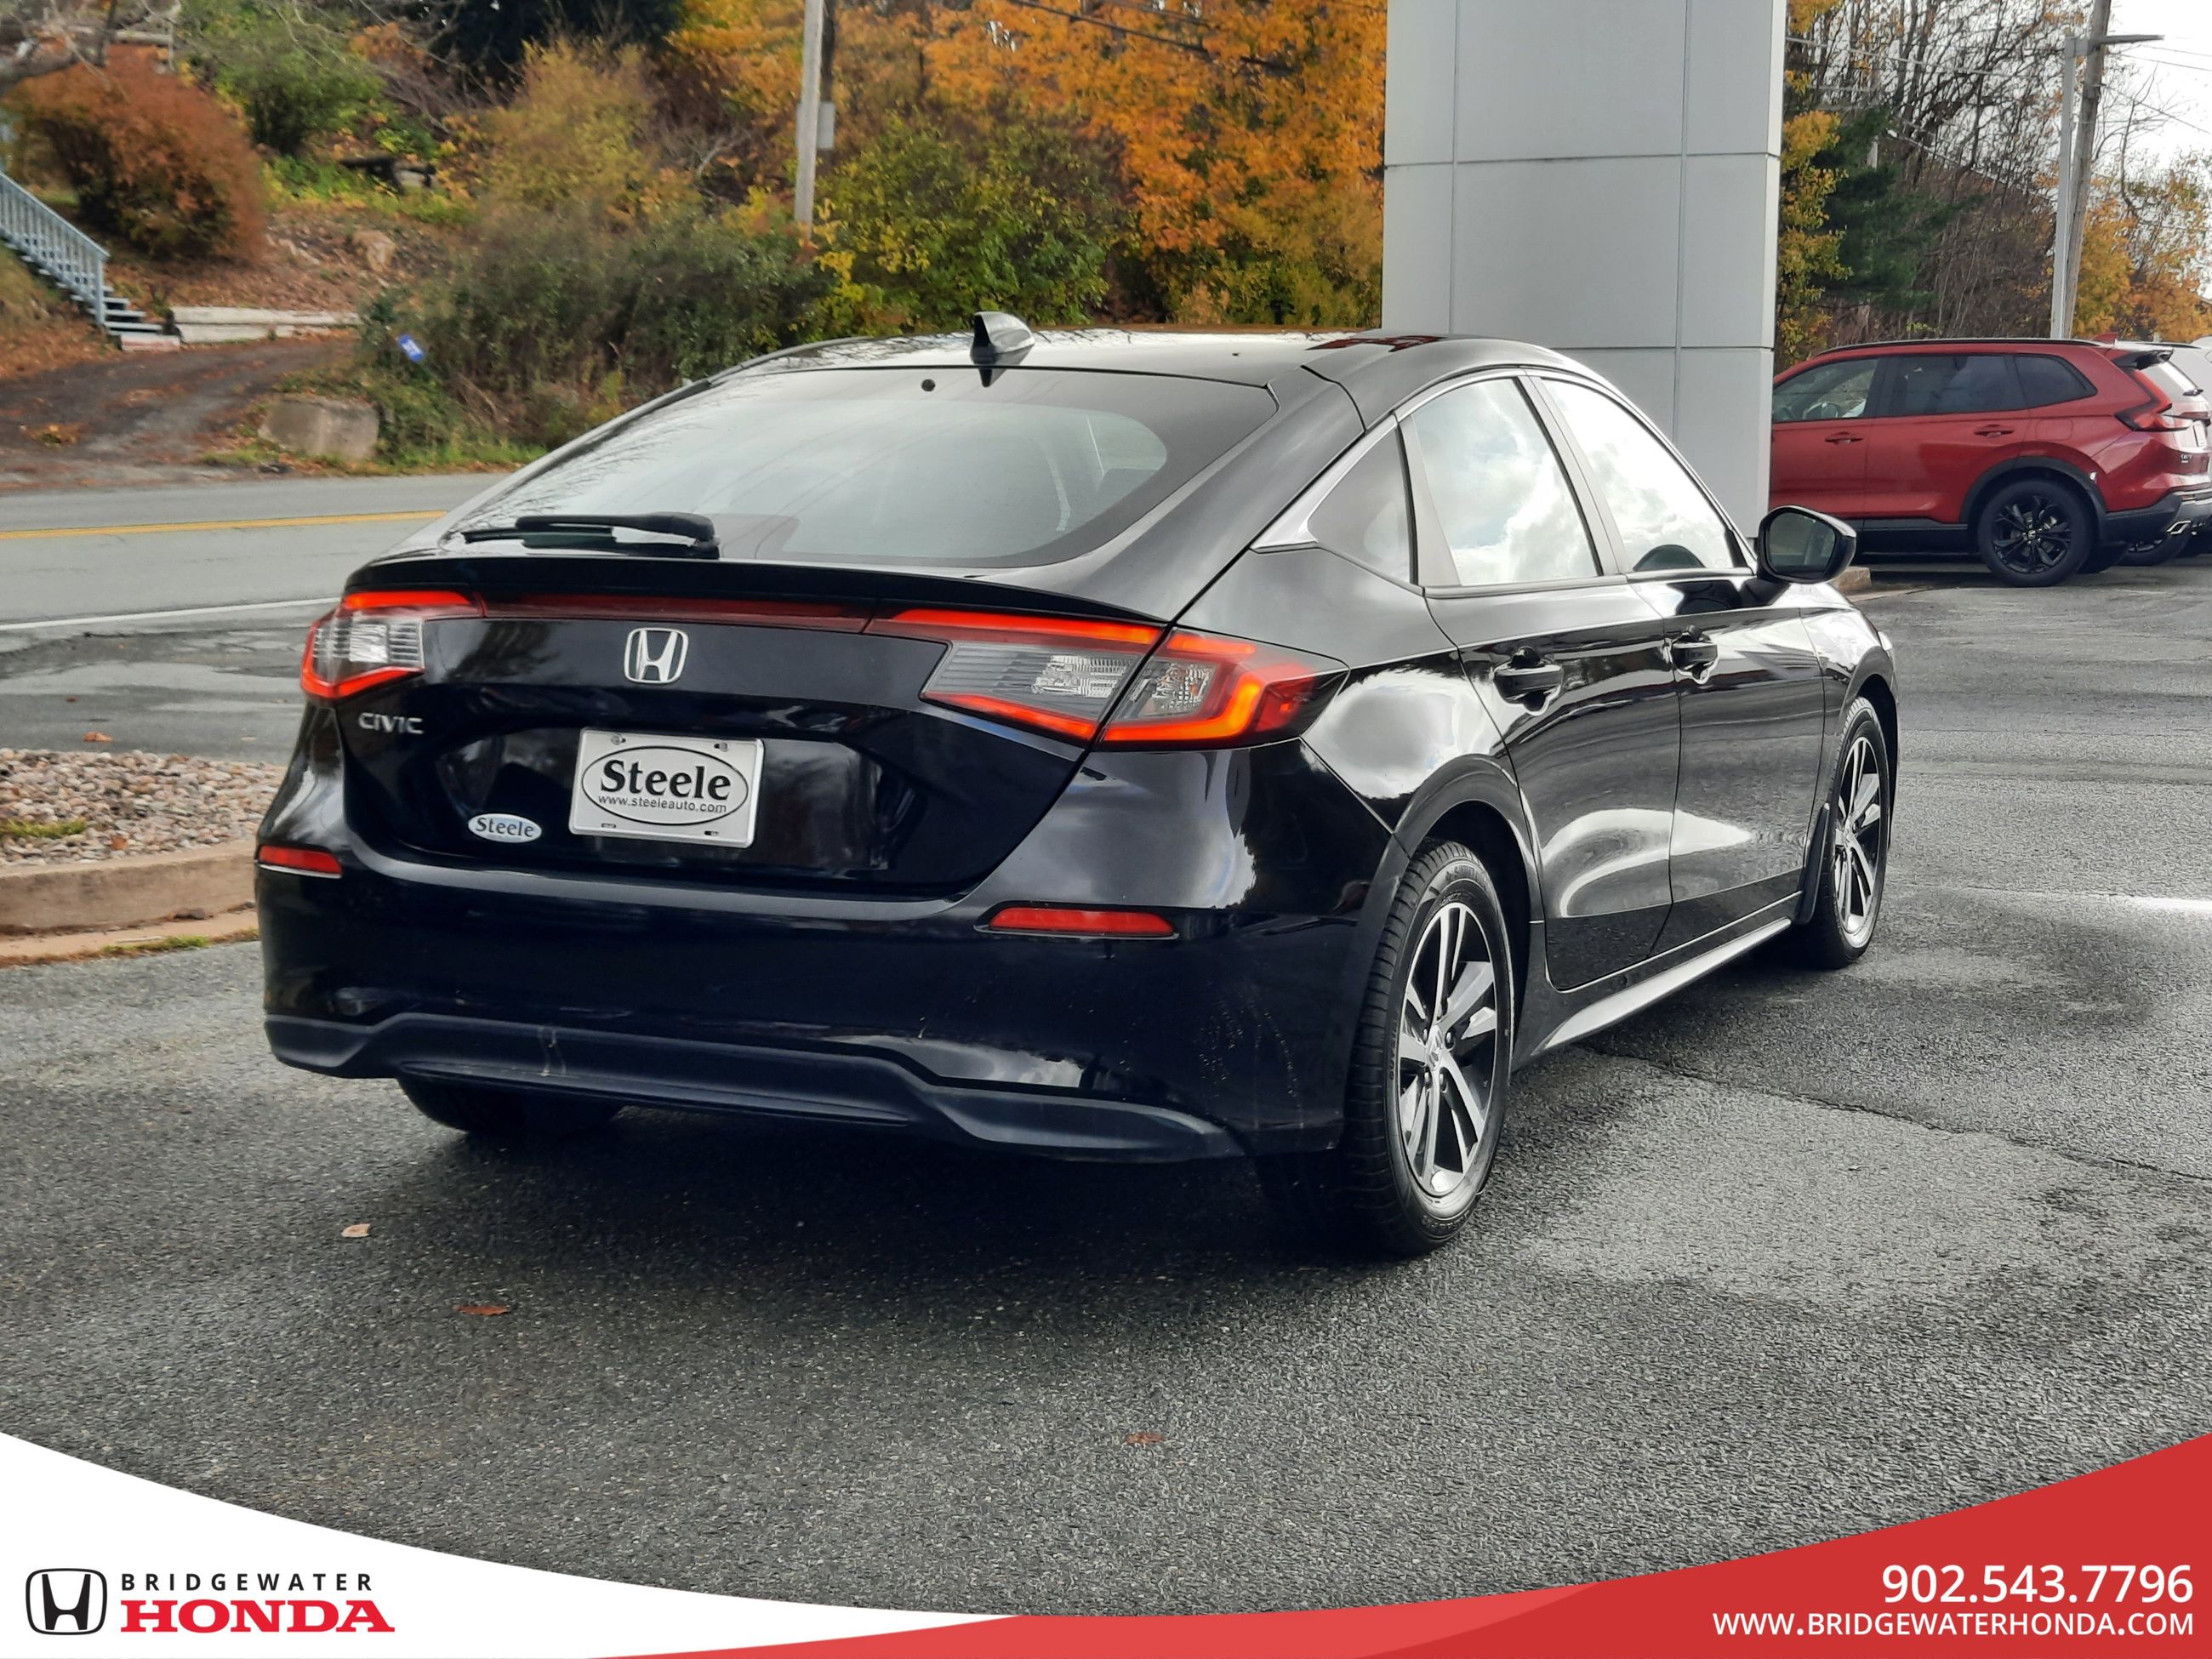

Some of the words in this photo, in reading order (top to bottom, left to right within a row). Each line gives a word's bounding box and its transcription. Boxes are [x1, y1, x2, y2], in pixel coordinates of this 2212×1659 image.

[358, 712, 424, 734] CIVIC
[600, 759, 732, 801] Steele
[598, 794, 727, 813] www.steeleauto.com
[476, 817, 534, 837] Steele
